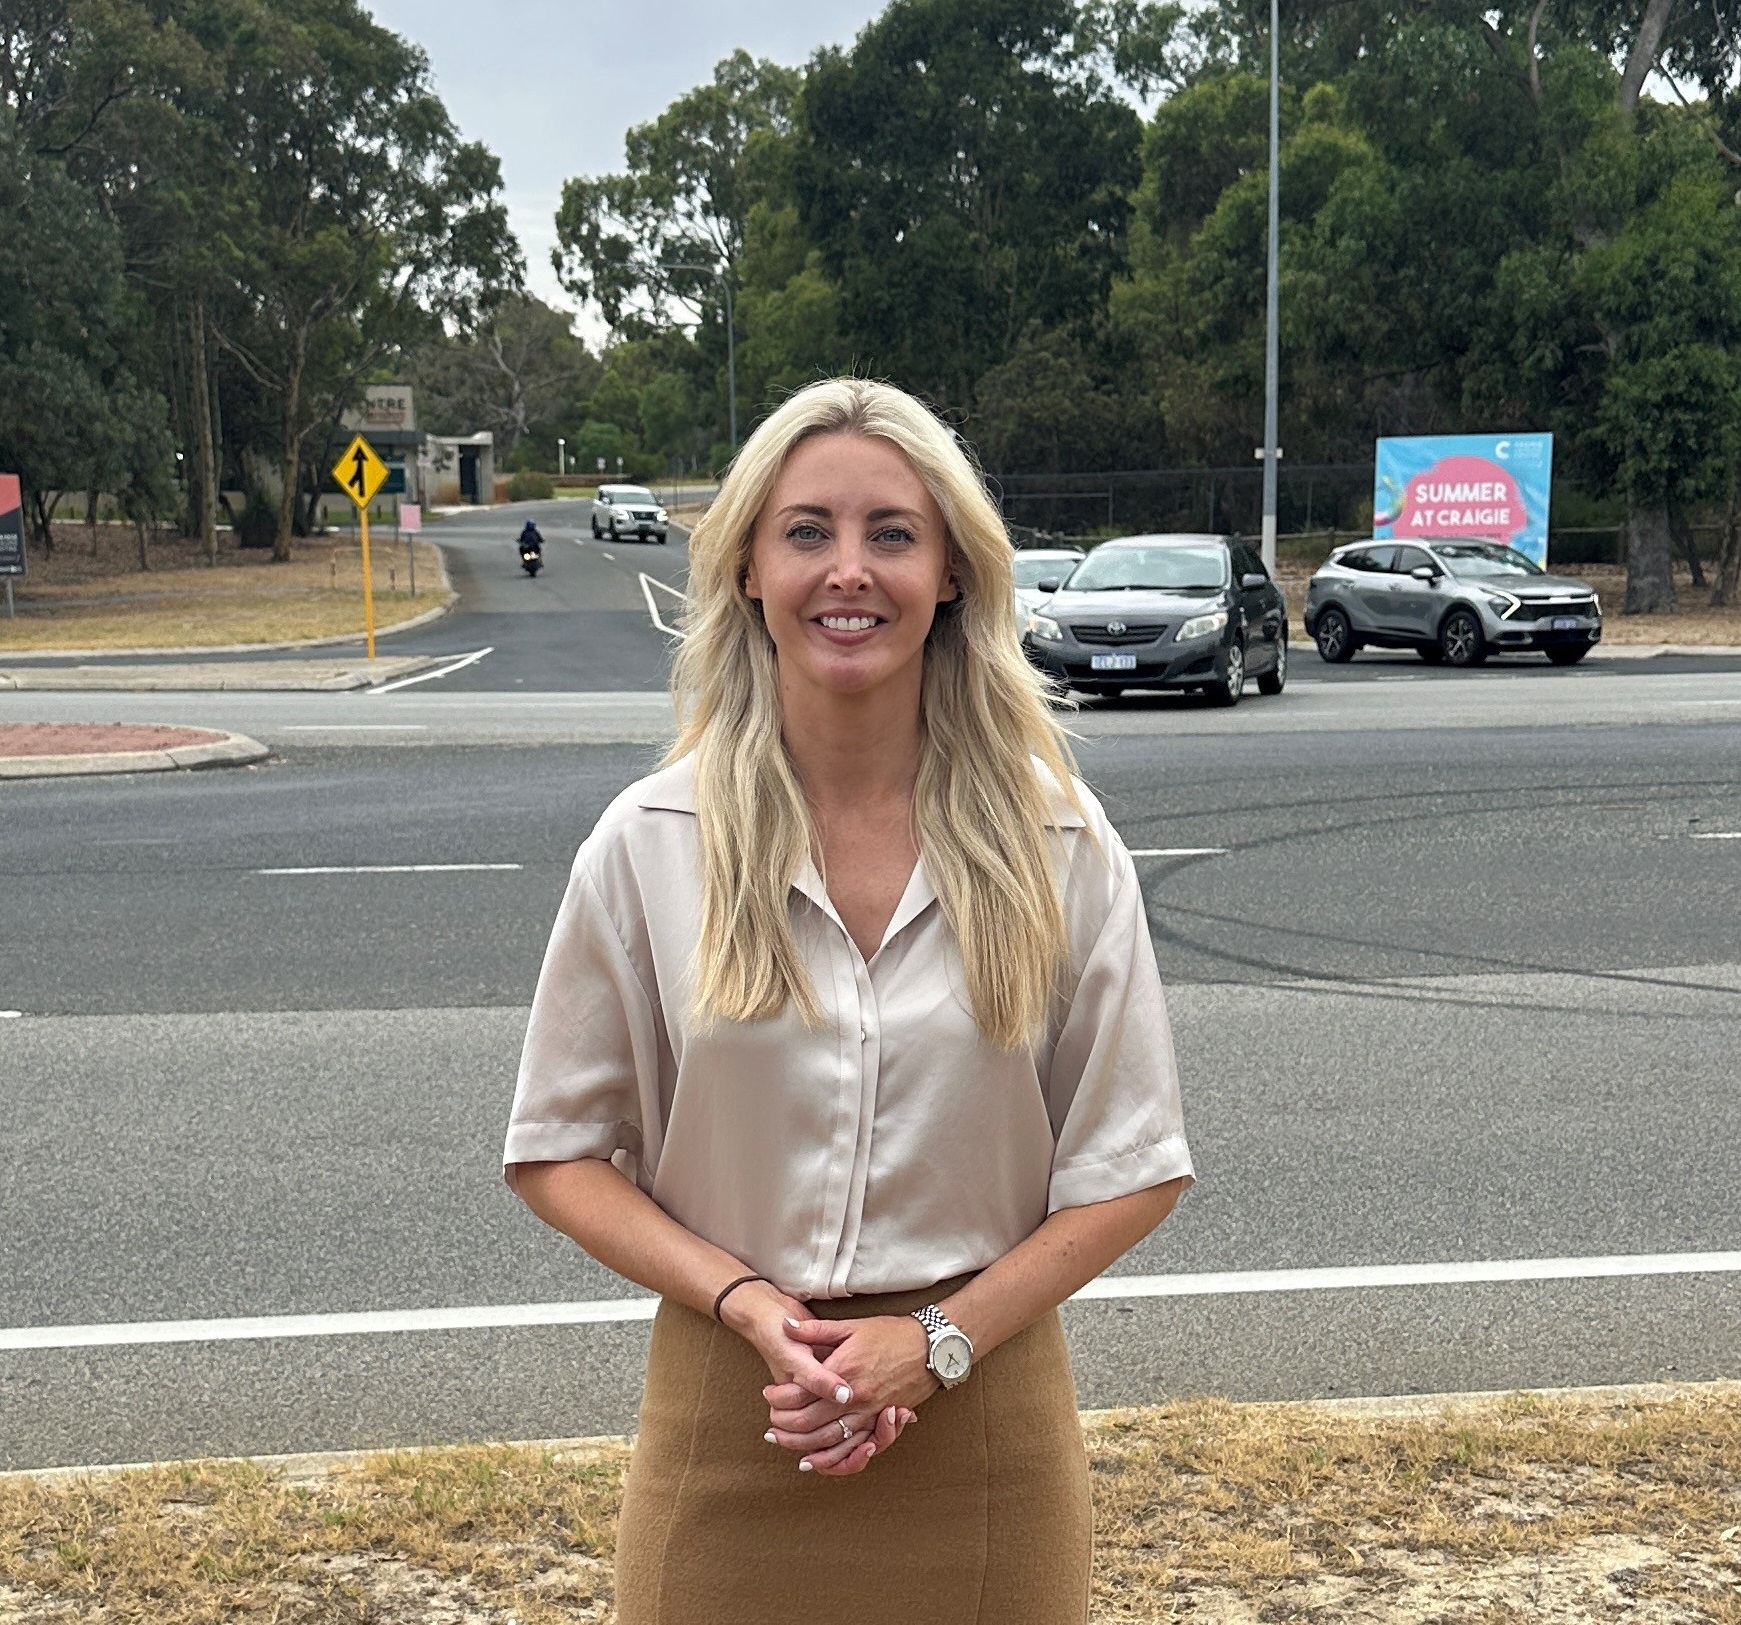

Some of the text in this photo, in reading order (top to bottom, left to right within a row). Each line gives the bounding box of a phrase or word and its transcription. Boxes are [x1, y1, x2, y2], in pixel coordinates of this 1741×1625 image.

[365, 398, 406, 410] NTRE
[1415, 481, 1507, 503] SUMMER
[1410, 508, 1511, 527] AT CRAIGIE
